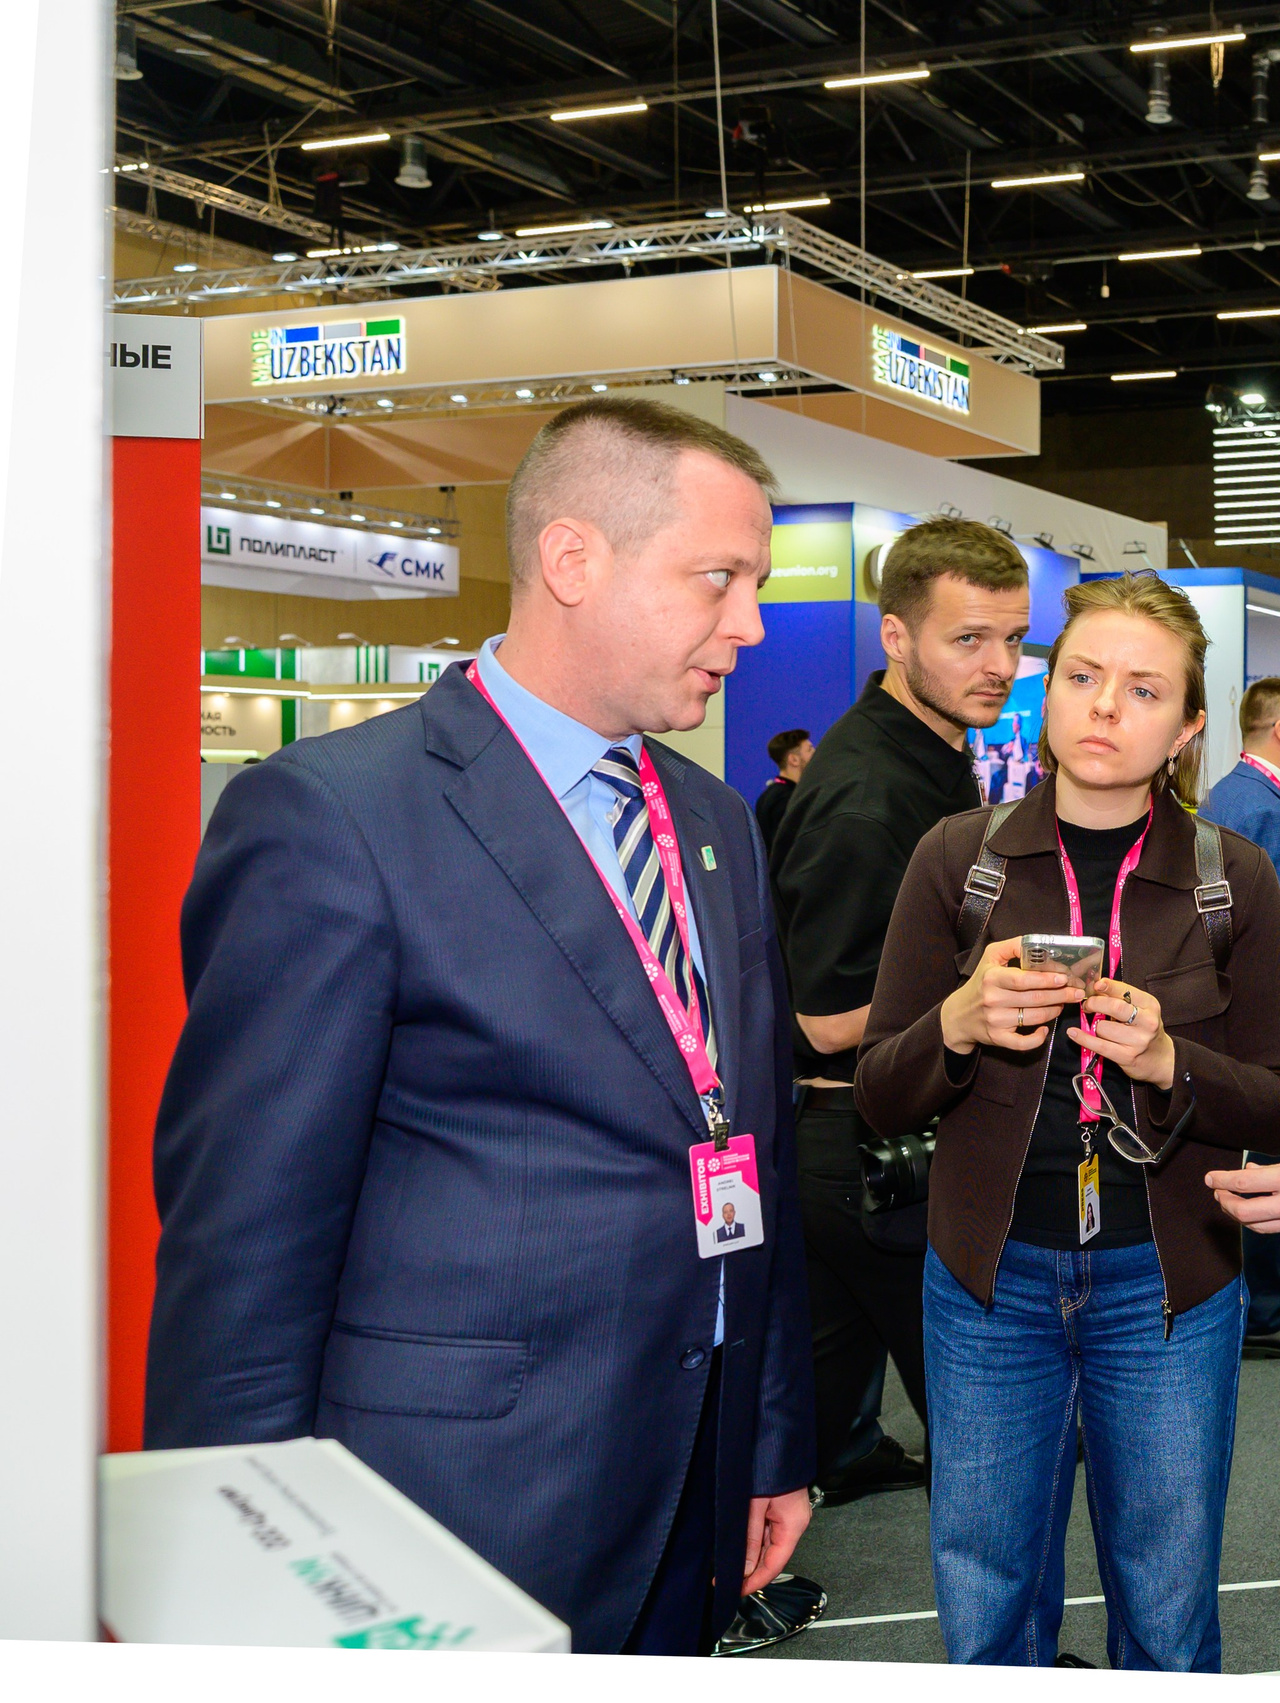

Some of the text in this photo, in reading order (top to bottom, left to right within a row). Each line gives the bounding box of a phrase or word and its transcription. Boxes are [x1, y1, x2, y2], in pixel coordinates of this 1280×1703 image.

[251, 329, 271, 382] MADE
[271, 337, 401, 380] UZBEKISTAN
[890, 351, 970, 411] UZBEKISTAN
[240, 537, 337, 563] ПОЛИПЛАСТ
[400, 558, 446, 581] СМК
[697, 1158, 710, 1216] EXHIBITOR
